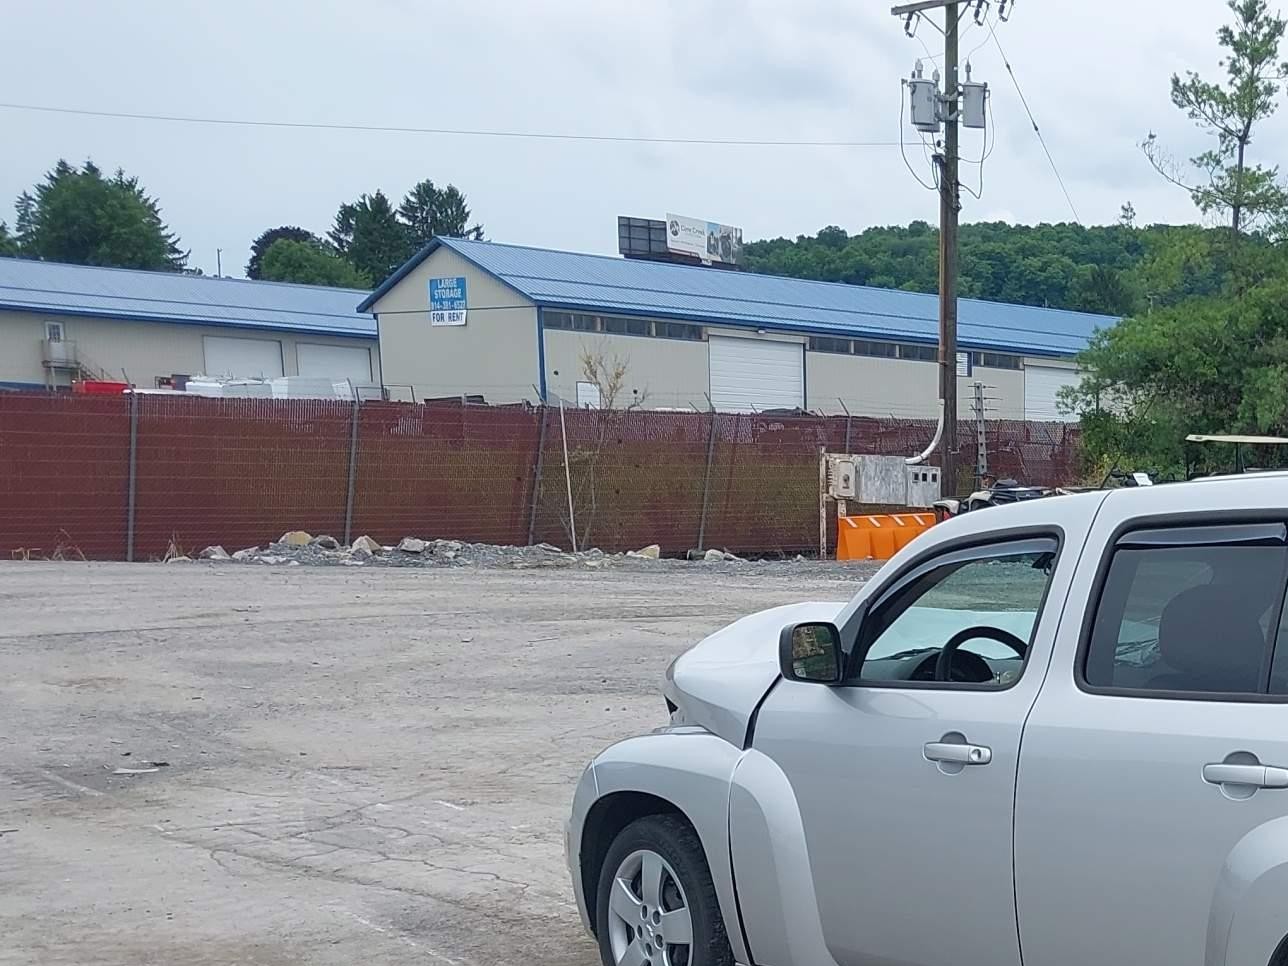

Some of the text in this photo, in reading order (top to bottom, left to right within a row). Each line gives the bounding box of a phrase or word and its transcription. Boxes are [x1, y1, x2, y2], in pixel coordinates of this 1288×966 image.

[437, 279, 457, 289] LARGE
[434, 289, 462, 299] STORAGE
[432, 311, 464, 322] FOR RENT
